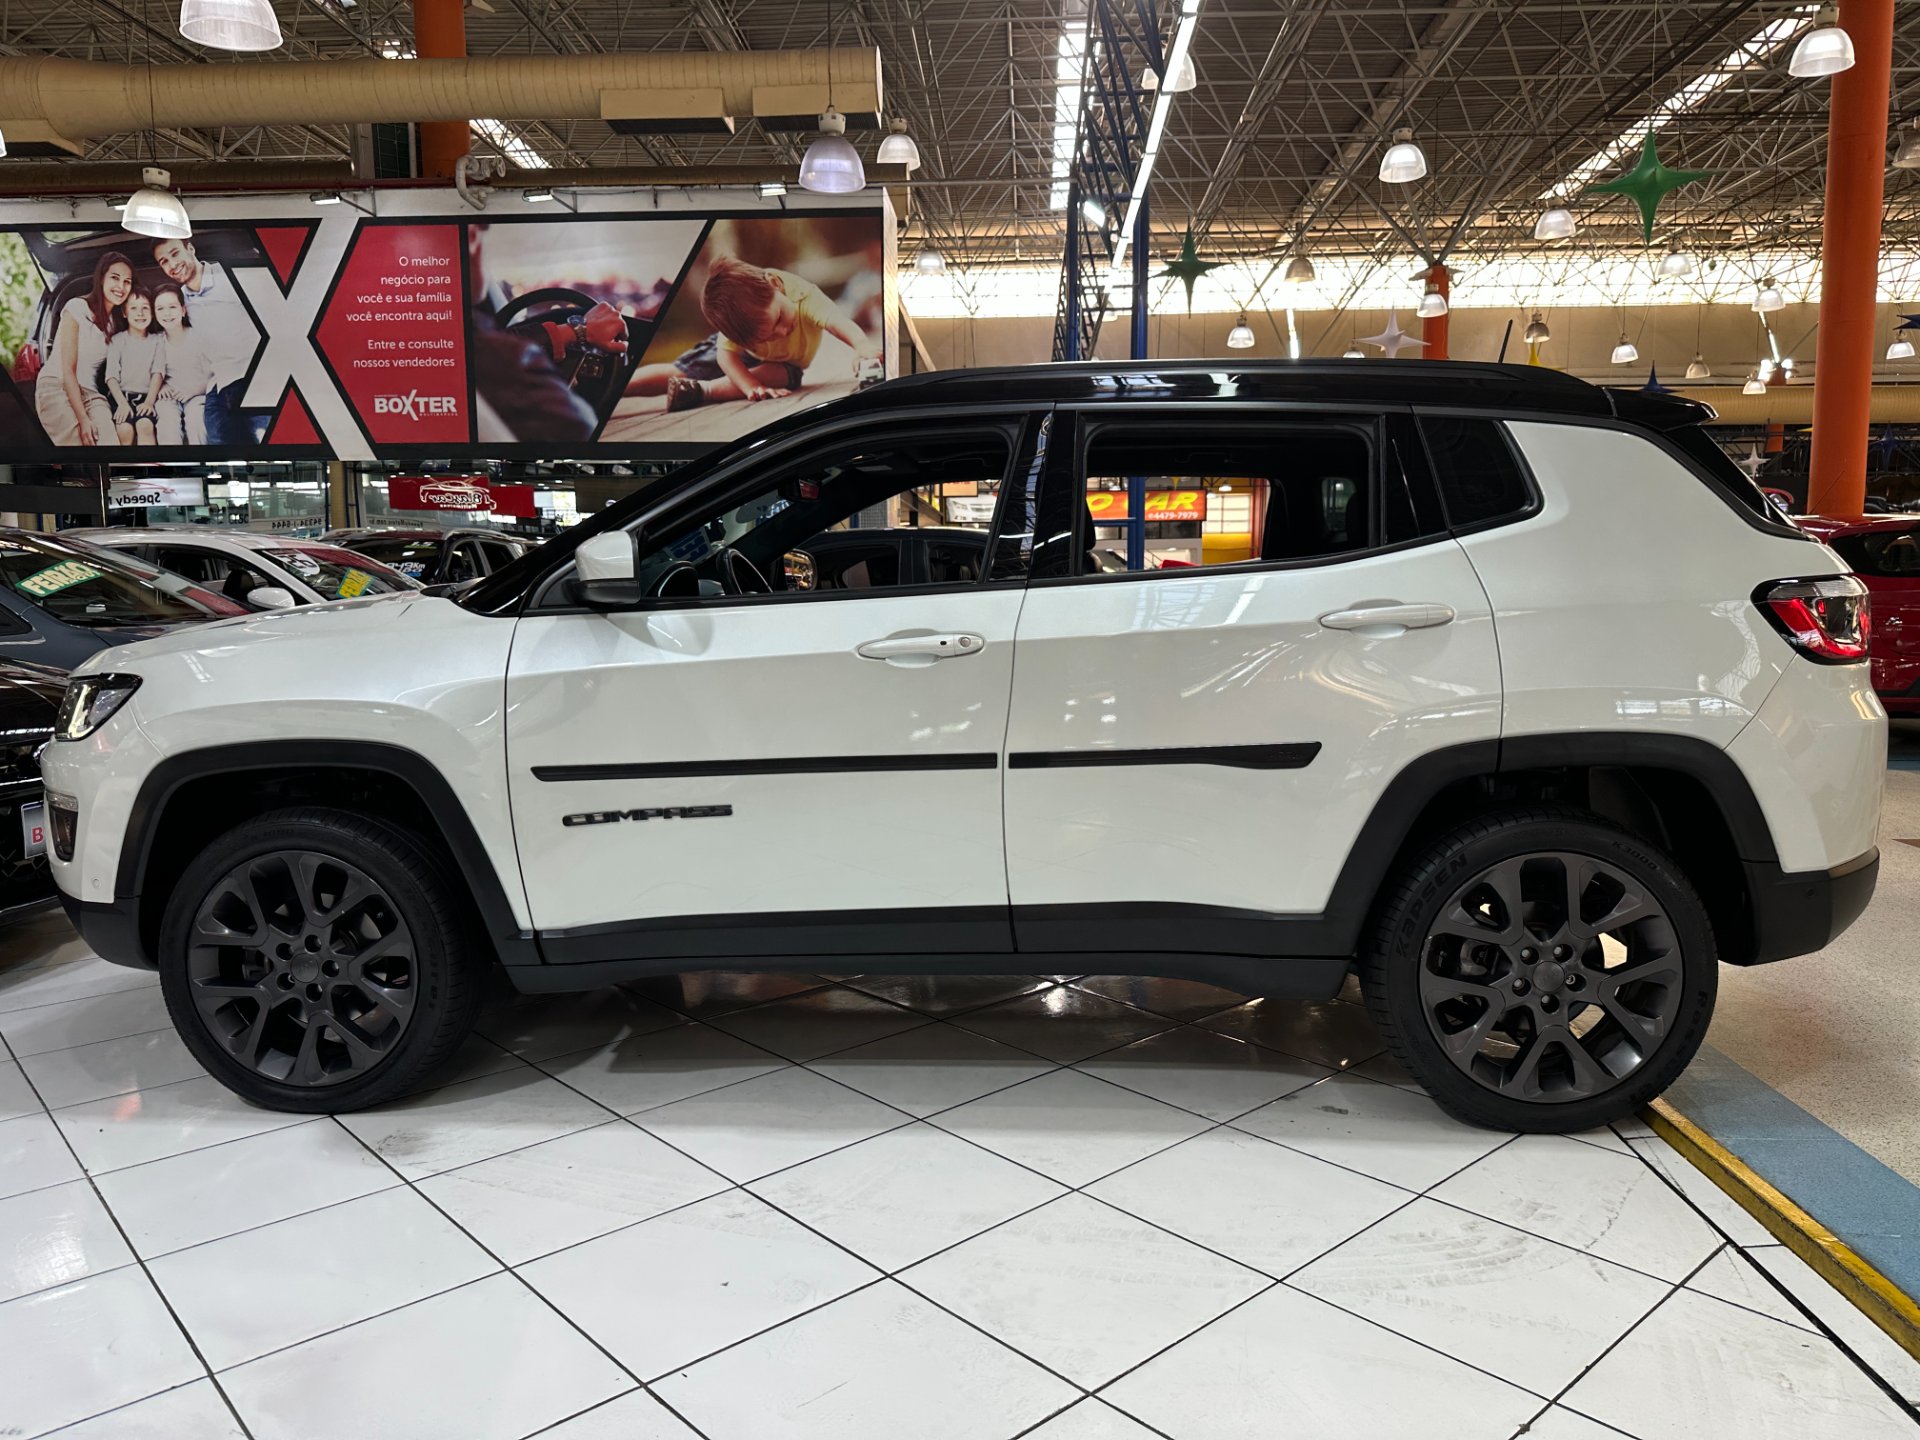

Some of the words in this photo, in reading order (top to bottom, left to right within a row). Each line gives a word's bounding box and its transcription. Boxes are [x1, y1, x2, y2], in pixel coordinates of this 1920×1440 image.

[399, 256, 409, 267] O
[411, 255, 451, 266] melhor
[380, 274, 425, 287] negócio
[427, 275, 451, 287] para
[357, 293, 383, 304] você
[385, 295, 392, 303] e
[395, 295, 414, 303] sua
[416, 292, 452, 303] família
[346, 311, 373, 322] você
[374, 311, 424, 321] encontra
[425, 310, 452, 322] aqui!
[368, 339, 396, 350] Entre
[398, 342, 405, 350] e
[407, 338, 454, 349] consulte
[353, 359, 390, 368] nossos
[392, 357, 455, 367] vendedores
[374, 389, 458, 421] BOXTER
[562, 804, 733, 826] COMPASS
